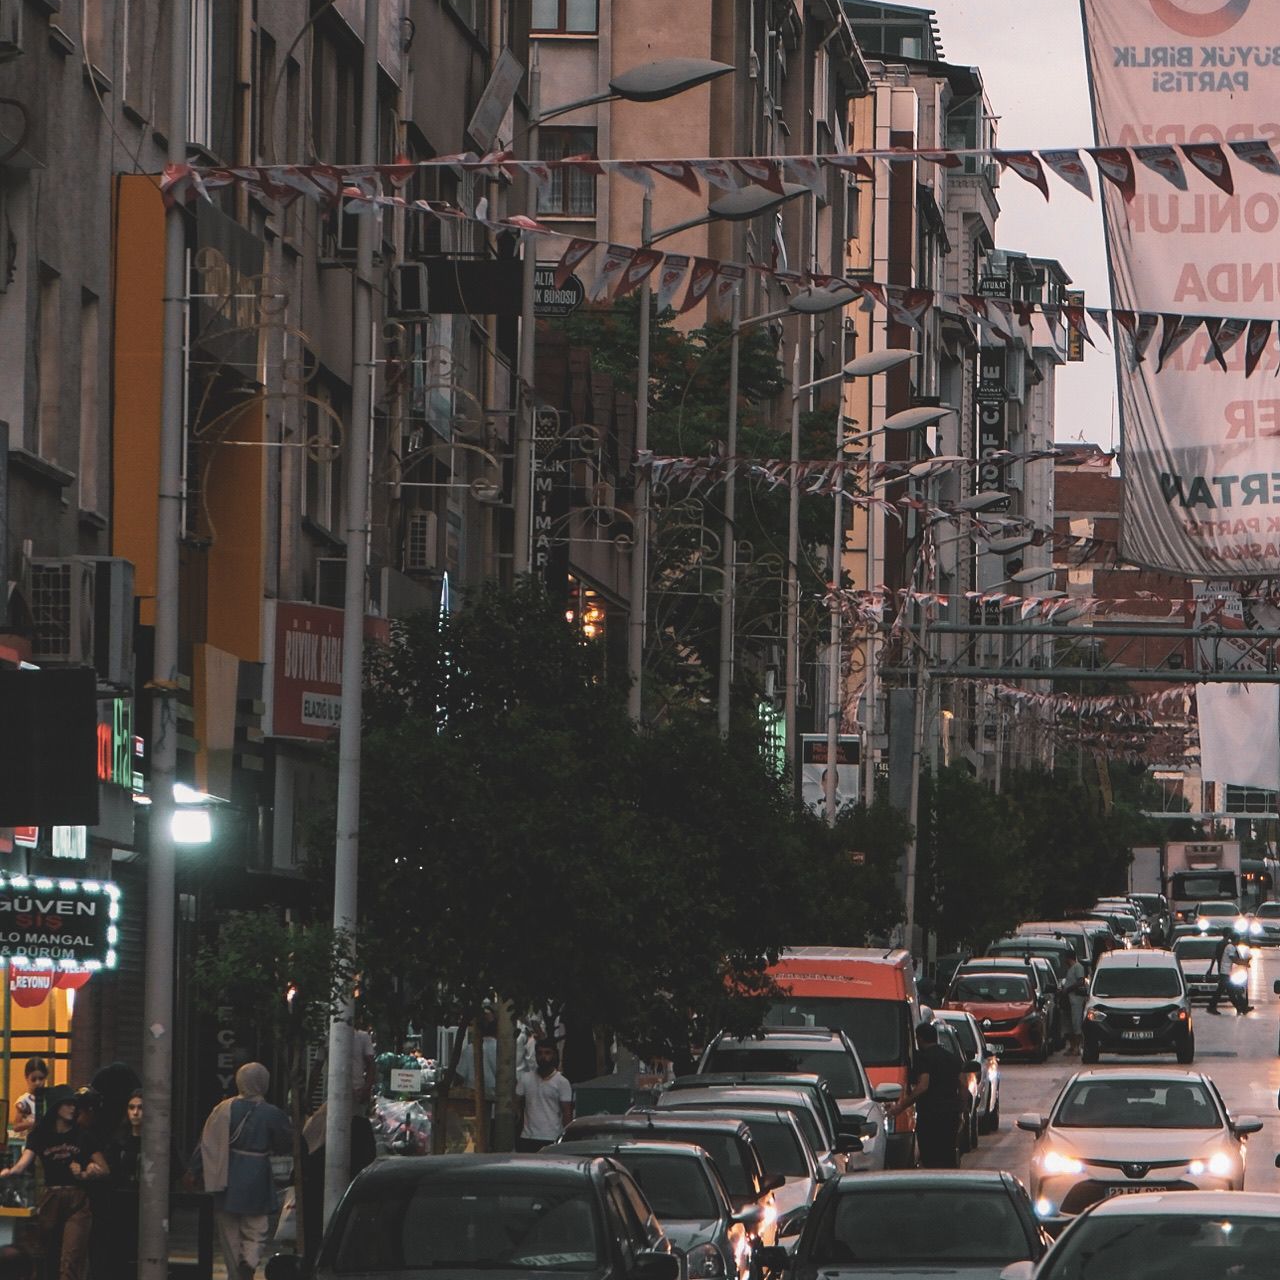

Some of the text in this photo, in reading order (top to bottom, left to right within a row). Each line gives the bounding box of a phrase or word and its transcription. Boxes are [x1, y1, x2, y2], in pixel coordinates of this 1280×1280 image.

[284, 619, 342, 685] BÜYÜK BİRL
[25, 932, 94, 946] MANGAL
[1, 945, 75, 959] & DÜRÜM
[16, 976, 50, 989] REYONU
